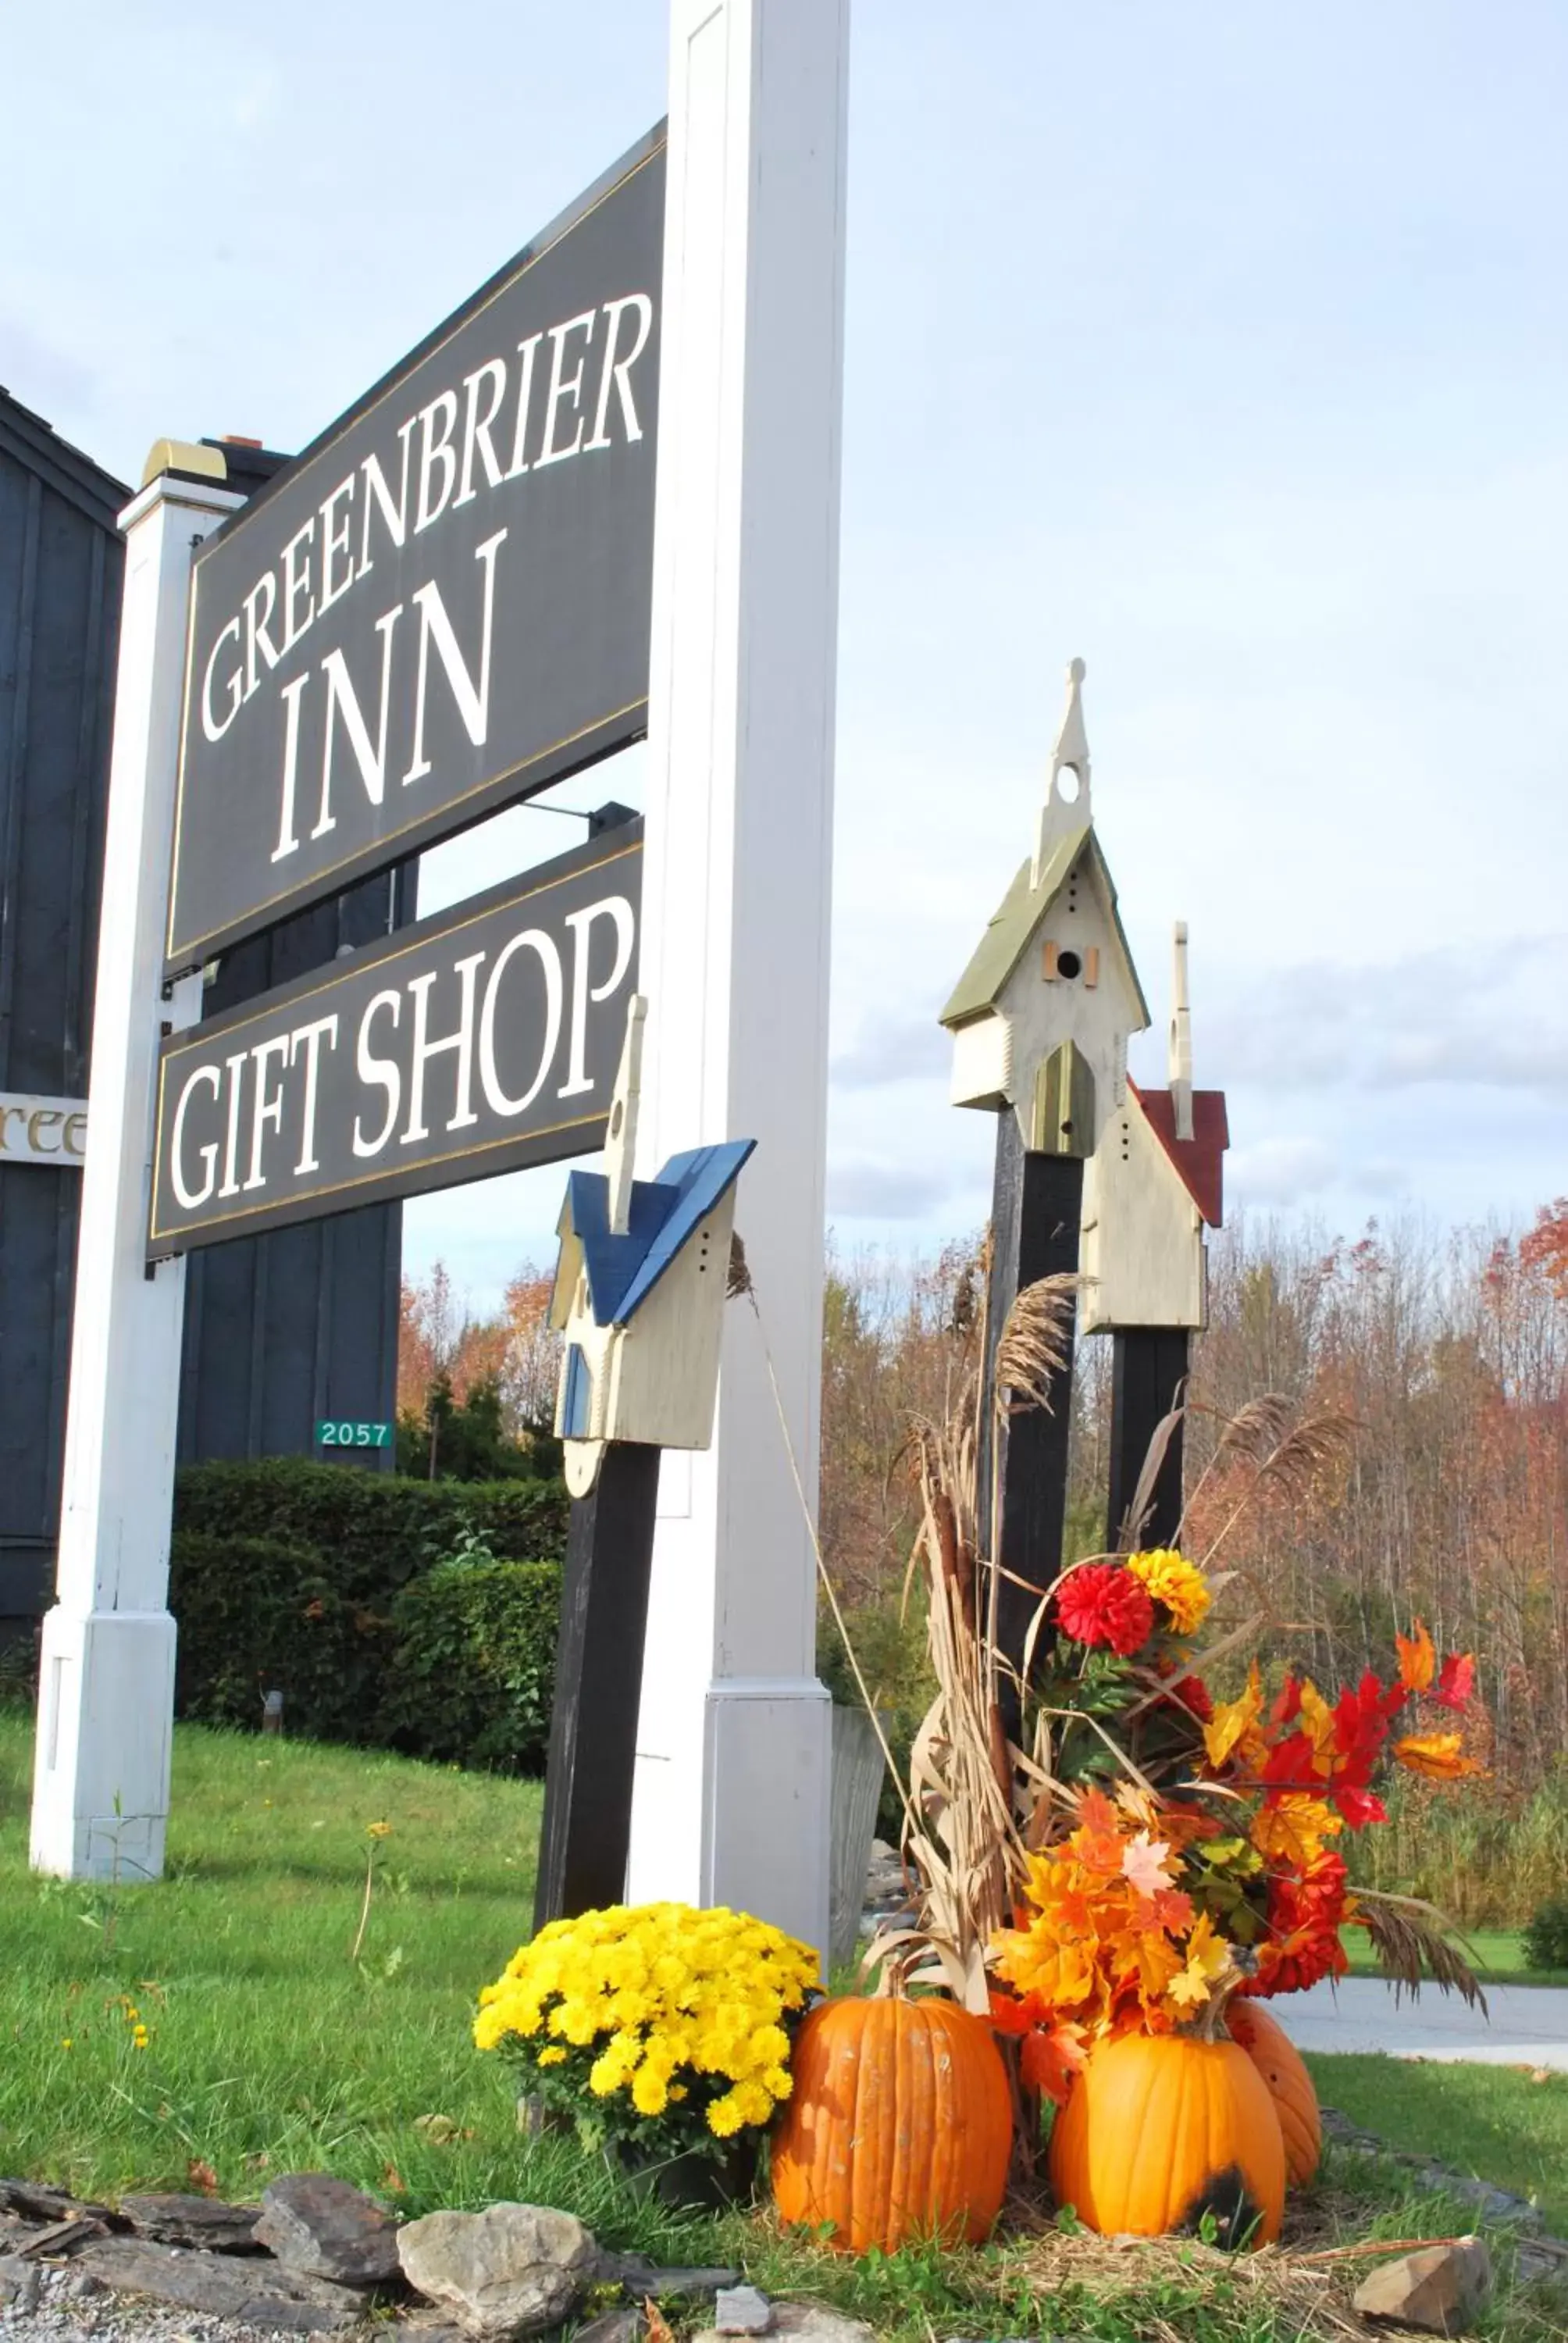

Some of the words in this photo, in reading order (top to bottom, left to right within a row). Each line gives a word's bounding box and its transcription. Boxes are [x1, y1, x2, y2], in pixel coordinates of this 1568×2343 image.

[201, 292, 653, 743] GREENBRIER
[271, 528, 508, 864] INN
[171, 1014, 337, 1210] GIFT
[352, 896, 635, 1158] SHOP
[322, 1423, 387, 1446] 2057
